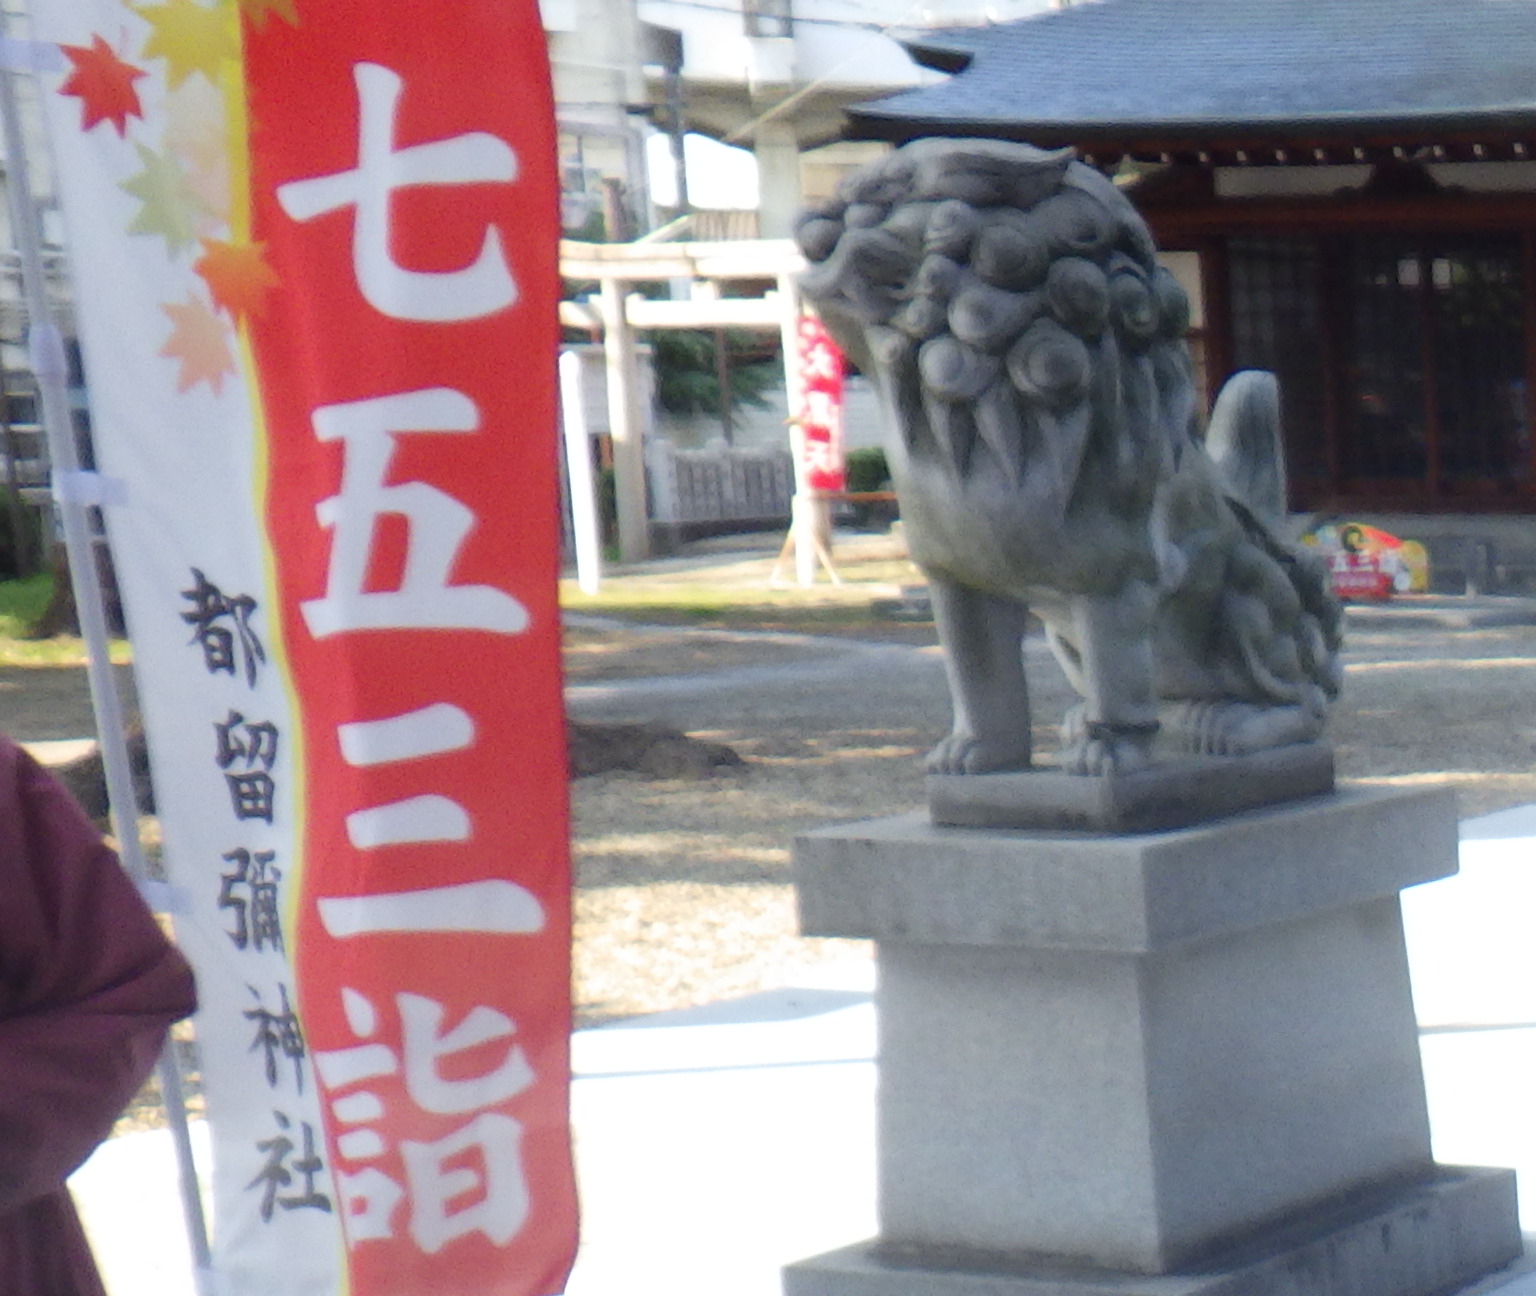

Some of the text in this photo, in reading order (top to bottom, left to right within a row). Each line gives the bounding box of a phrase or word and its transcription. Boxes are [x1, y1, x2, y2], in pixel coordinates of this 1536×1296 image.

[179, 566, 332, 1222] 都留彌神社
[276, 62, 546, 1256] 七五三詣
